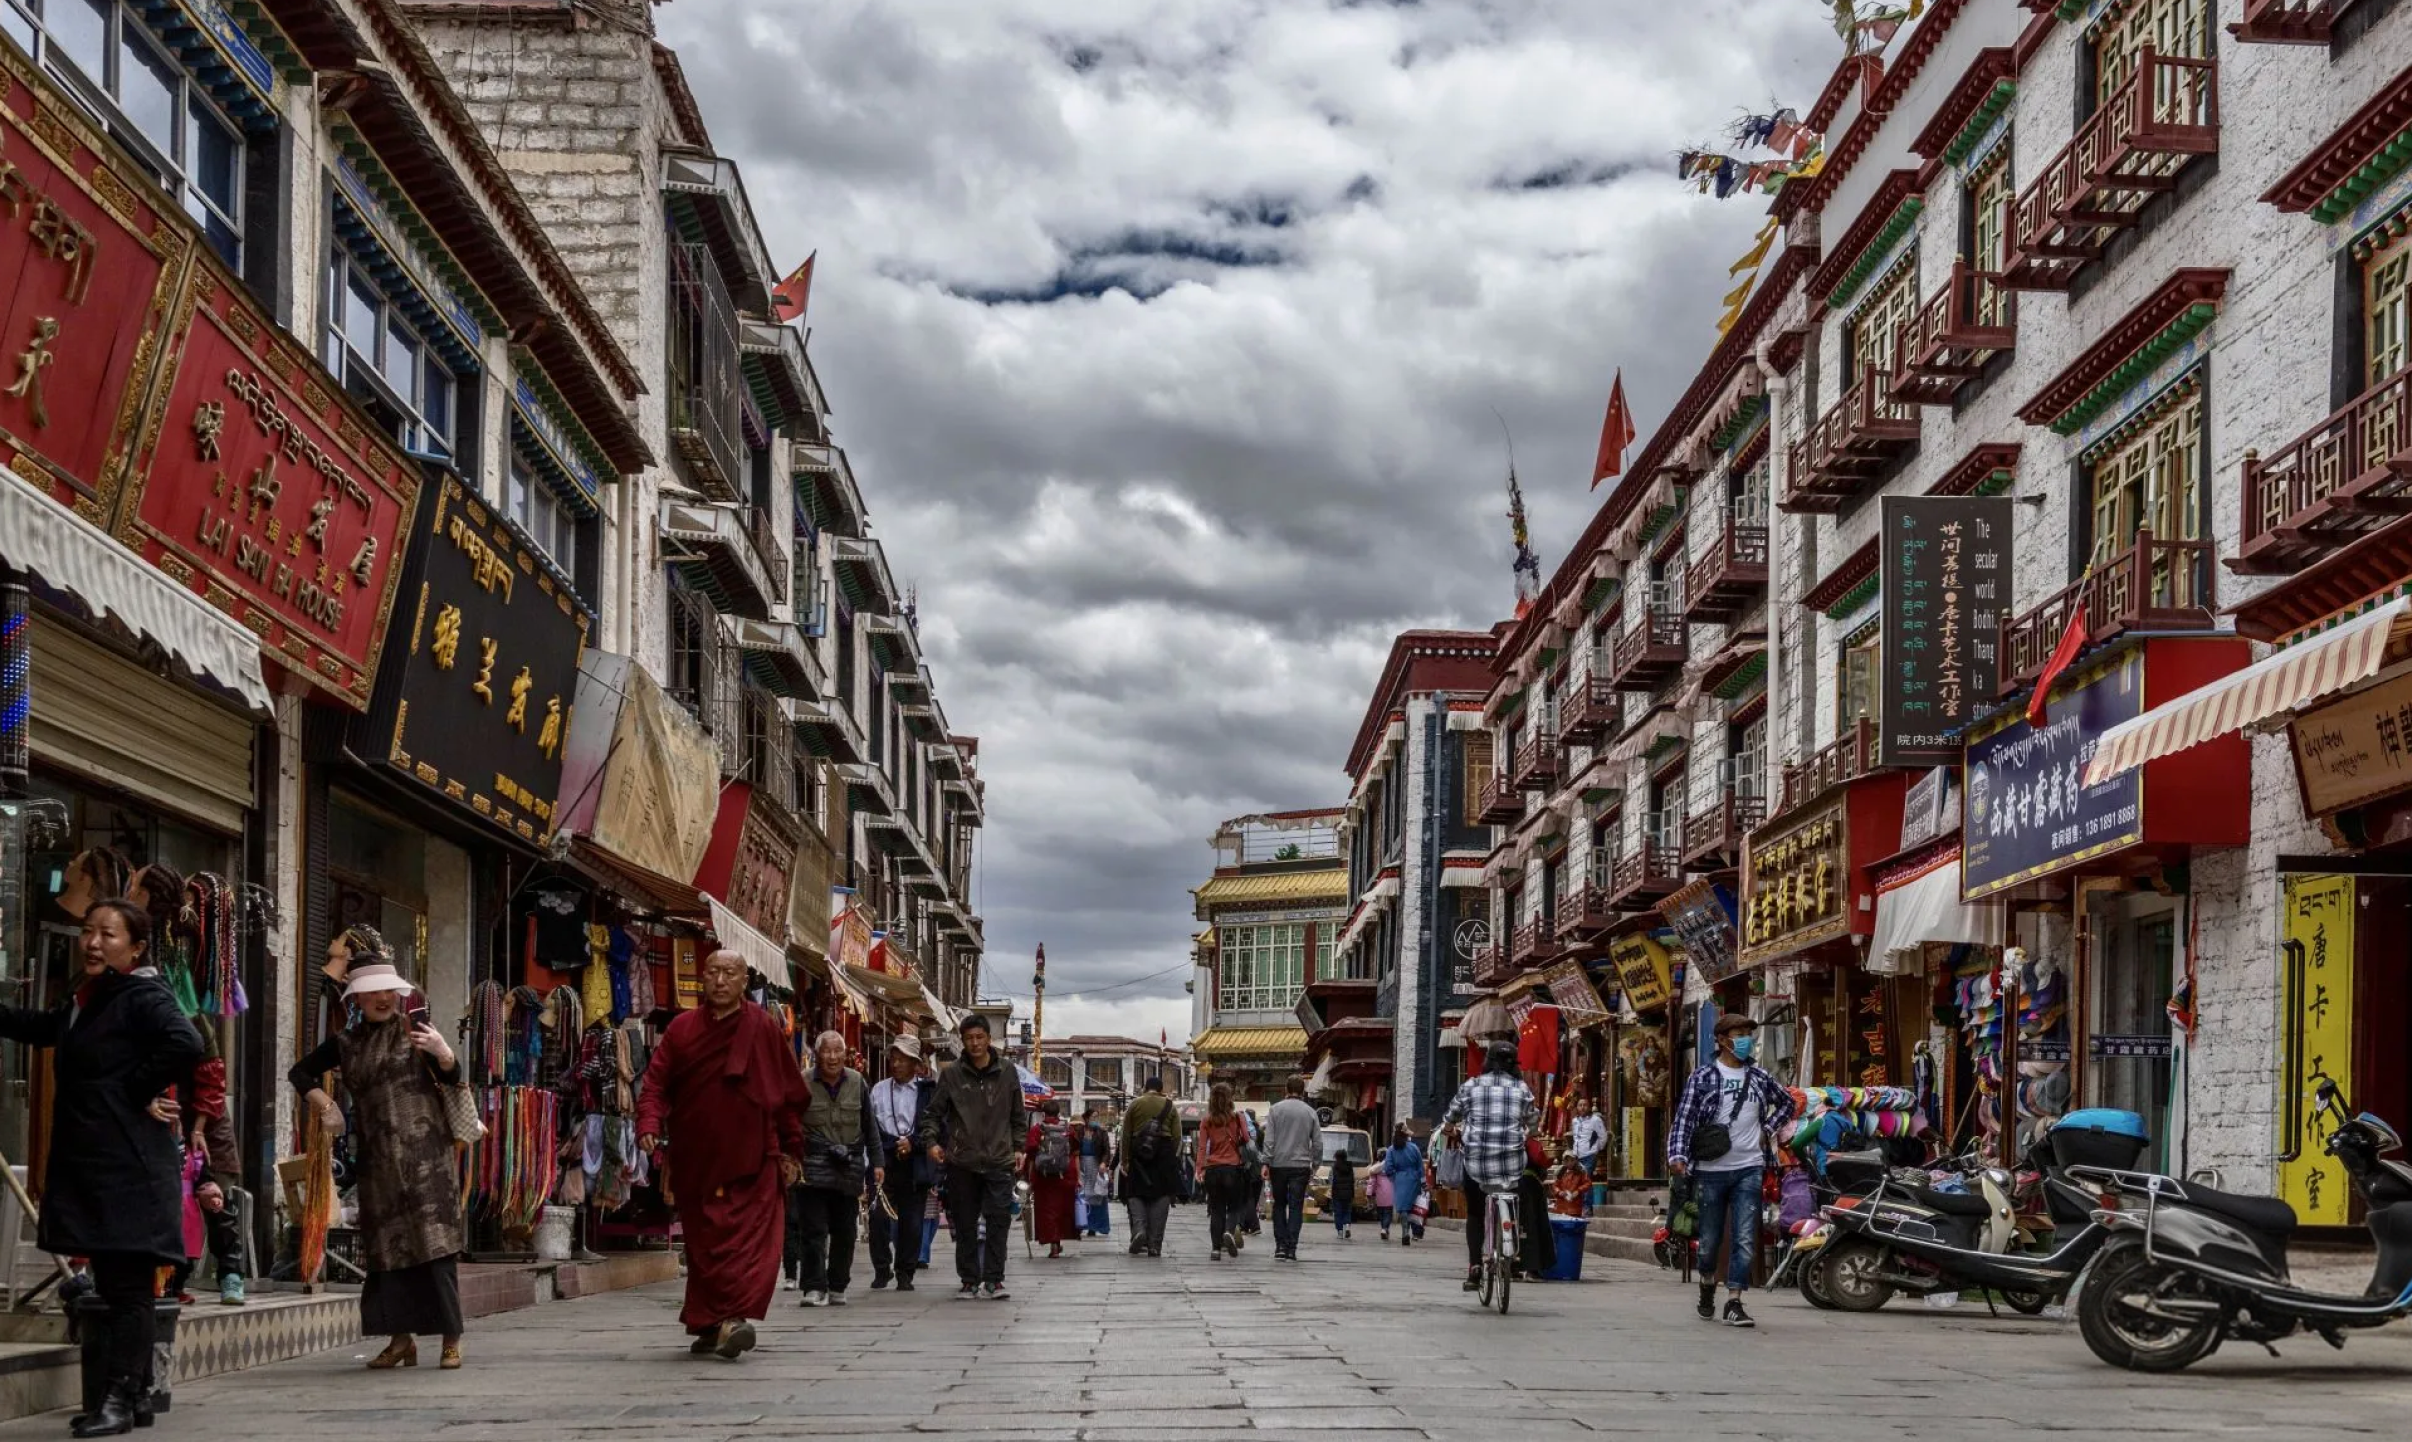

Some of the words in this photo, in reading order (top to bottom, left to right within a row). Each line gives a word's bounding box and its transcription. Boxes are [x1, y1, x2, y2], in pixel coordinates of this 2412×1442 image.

[1976, 518, 1991, 539] The
[1975, 548, 1998, 569] secular
[198, 506, 234, 557] LAI
[236, 533, 272, 585] SAN
[272, 561, 295, 602] FA
[297, 575, 344, 633] HOUSE
[1975, 578, 1995, 600] world
[1973, 638, 1994, 665] Thang
[1973, 669, 1983, 690] ka
[2086, 818, 2099, 837] 136
[2304, 921, 2330, 1210] 唐卡工作室
